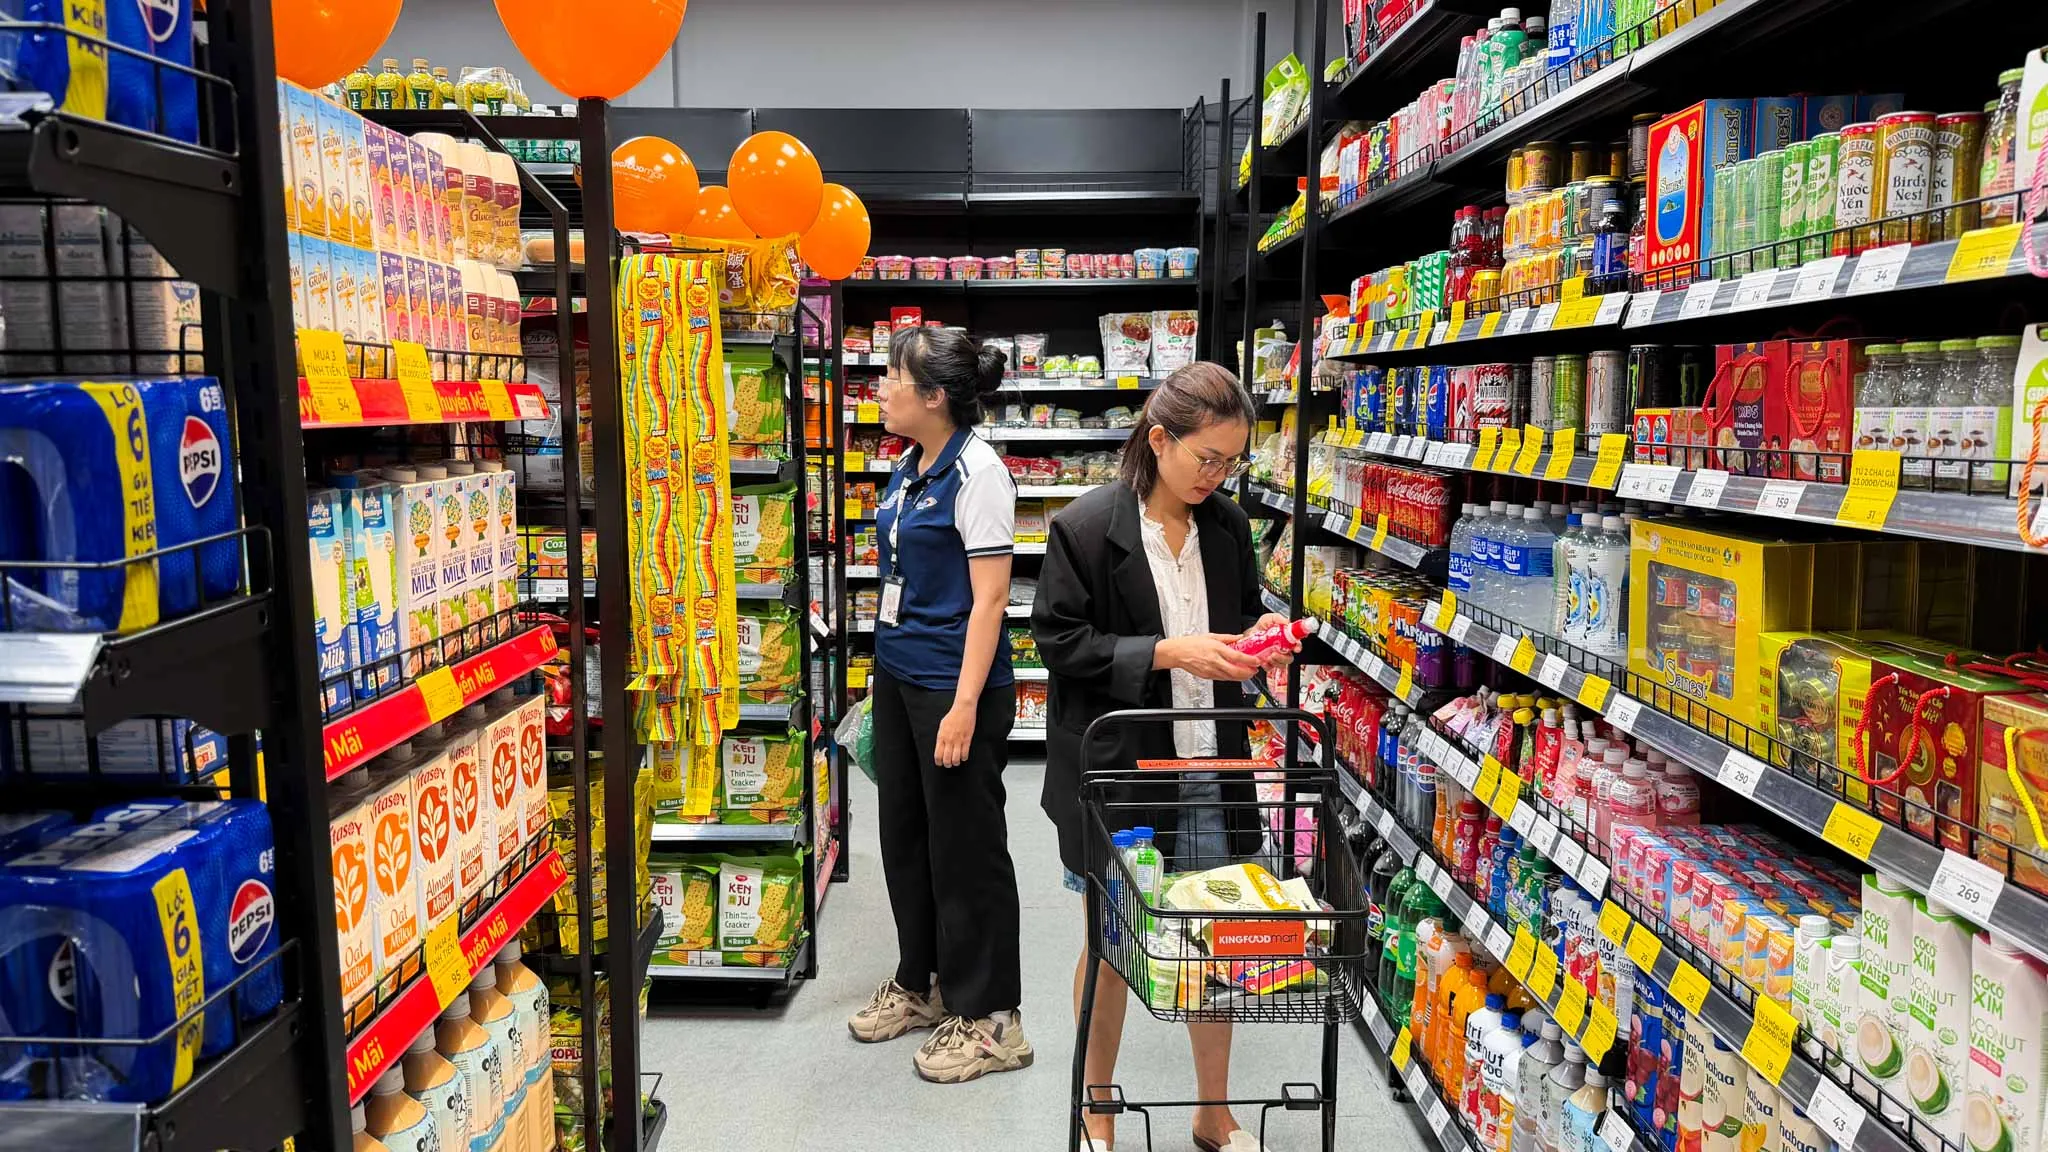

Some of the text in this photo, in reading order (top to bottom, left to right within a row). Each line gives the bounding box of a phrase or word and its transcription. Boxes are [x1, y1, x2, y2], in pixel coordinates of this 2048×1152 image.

[293, 125, 314, 138] GROW
[322, 136, 342, 150] GROW
[1892, 174, 1927, 188] Bird's
[1840, 184, 1870, 198] Nước
[1895, 187, 1924, 201] Nest
[1841, 197, 1863, 209] Yến
[308, 271, 329, 287] GROW
[336, 277, 354, 292] GROW
[1818, 279, 1826, 290] 8
[1873, 269, 1888, 282] 34
[360, 281, 377, 297] GROW
[199, 387, 212, 412] 6
[127, 407, 144, 463] 6
[183, 448, 216, 475] PEPSI
[1869, 468, 1885, 477] CHAI
[1885, 467, 1896, 478] GIÁ
[1701, 488, 1714, 498] 209
[735, 503, 749, 513] EN
[1775, 497, 1789, 509] 159
[471, 554, 493, 575] MILK
[500, 547, 517, 566] MILK
[443, 562, 467, 584] MILK
[412, 571, 436, 595] MILK
[738, 624, 750, 634] EN
[375, 628, 396, 653] Milk
[320, 647, 345, 672] Milk
[457, 661, 496, 698] yến Mãi
[1665, 657, 1708, 700] Sanest
[1618, 710, 1629, 722] 325
[330, 726, 363, 760] Mãi
[732, 744, 756, 754] KEN
[742, 753, 755, 765] JU
[414, 767, 446, 797] Vitasoy
[730, 769, 746, 777] Thin
[730, 778, 756, 787] Cracker
[1733, 769, 1749, 785] 290
[370, 792, 407, 825] Vitasoy
[1846, 831, 1862, 848] 145
[460, 840, 482, 867] Almond
[426, 864, 454, 900] Almond
[728, 883, 752, 894] KEN
[659, 895, 673, 906] JU
[737, 894, 750, 906] JU
[1956, 884, 1980, 904] 269
[231, 900, 271, 944] PEPSI
[390, 904, 408, 928] Oat
[724, 920, 750, 929] Cracker
[725, 911, 740, 919] Thin
[1863, 908, 1889, 931] COCO
[172, 911, 190, 958] 6
[487, 912, 508, 944] Mãi
[1863, 923, 1888, 949] XIM
[390, 926, 413, 950] Milky
[1218, 931, 1298, 945] KINGFOODmart
[1913, 935, 1937, 959] COCO
[345, 939, 364, 968] Oat
[1795, 951, 1810, 965] COCO
[1912, 949, 1936, 976] XIM
[176, 955, 196, 983] GIÁ
[343, 963, 368, 990] Milky
[1795, 959, 1809, 975] XIM
[451, 969, 461, 985] 95
[1827, 972, 1841, 986] COCO
[1973, 973, 2005, 1000] COCO
[1826, 981, 1840, 997] XIM
[1973, 989, 2004, 1021] XIM
[1468, 1020, 1482, 1040] tri
[354, 1036, 384, 1077] Mãi
[1482, 1045, 1504, 1067] nut
[1703, 1055, 1735, 1086] habaa
[1833, 1115, 1846, 1133] 43
[1779, 1120, 1817, 1151] habaa
